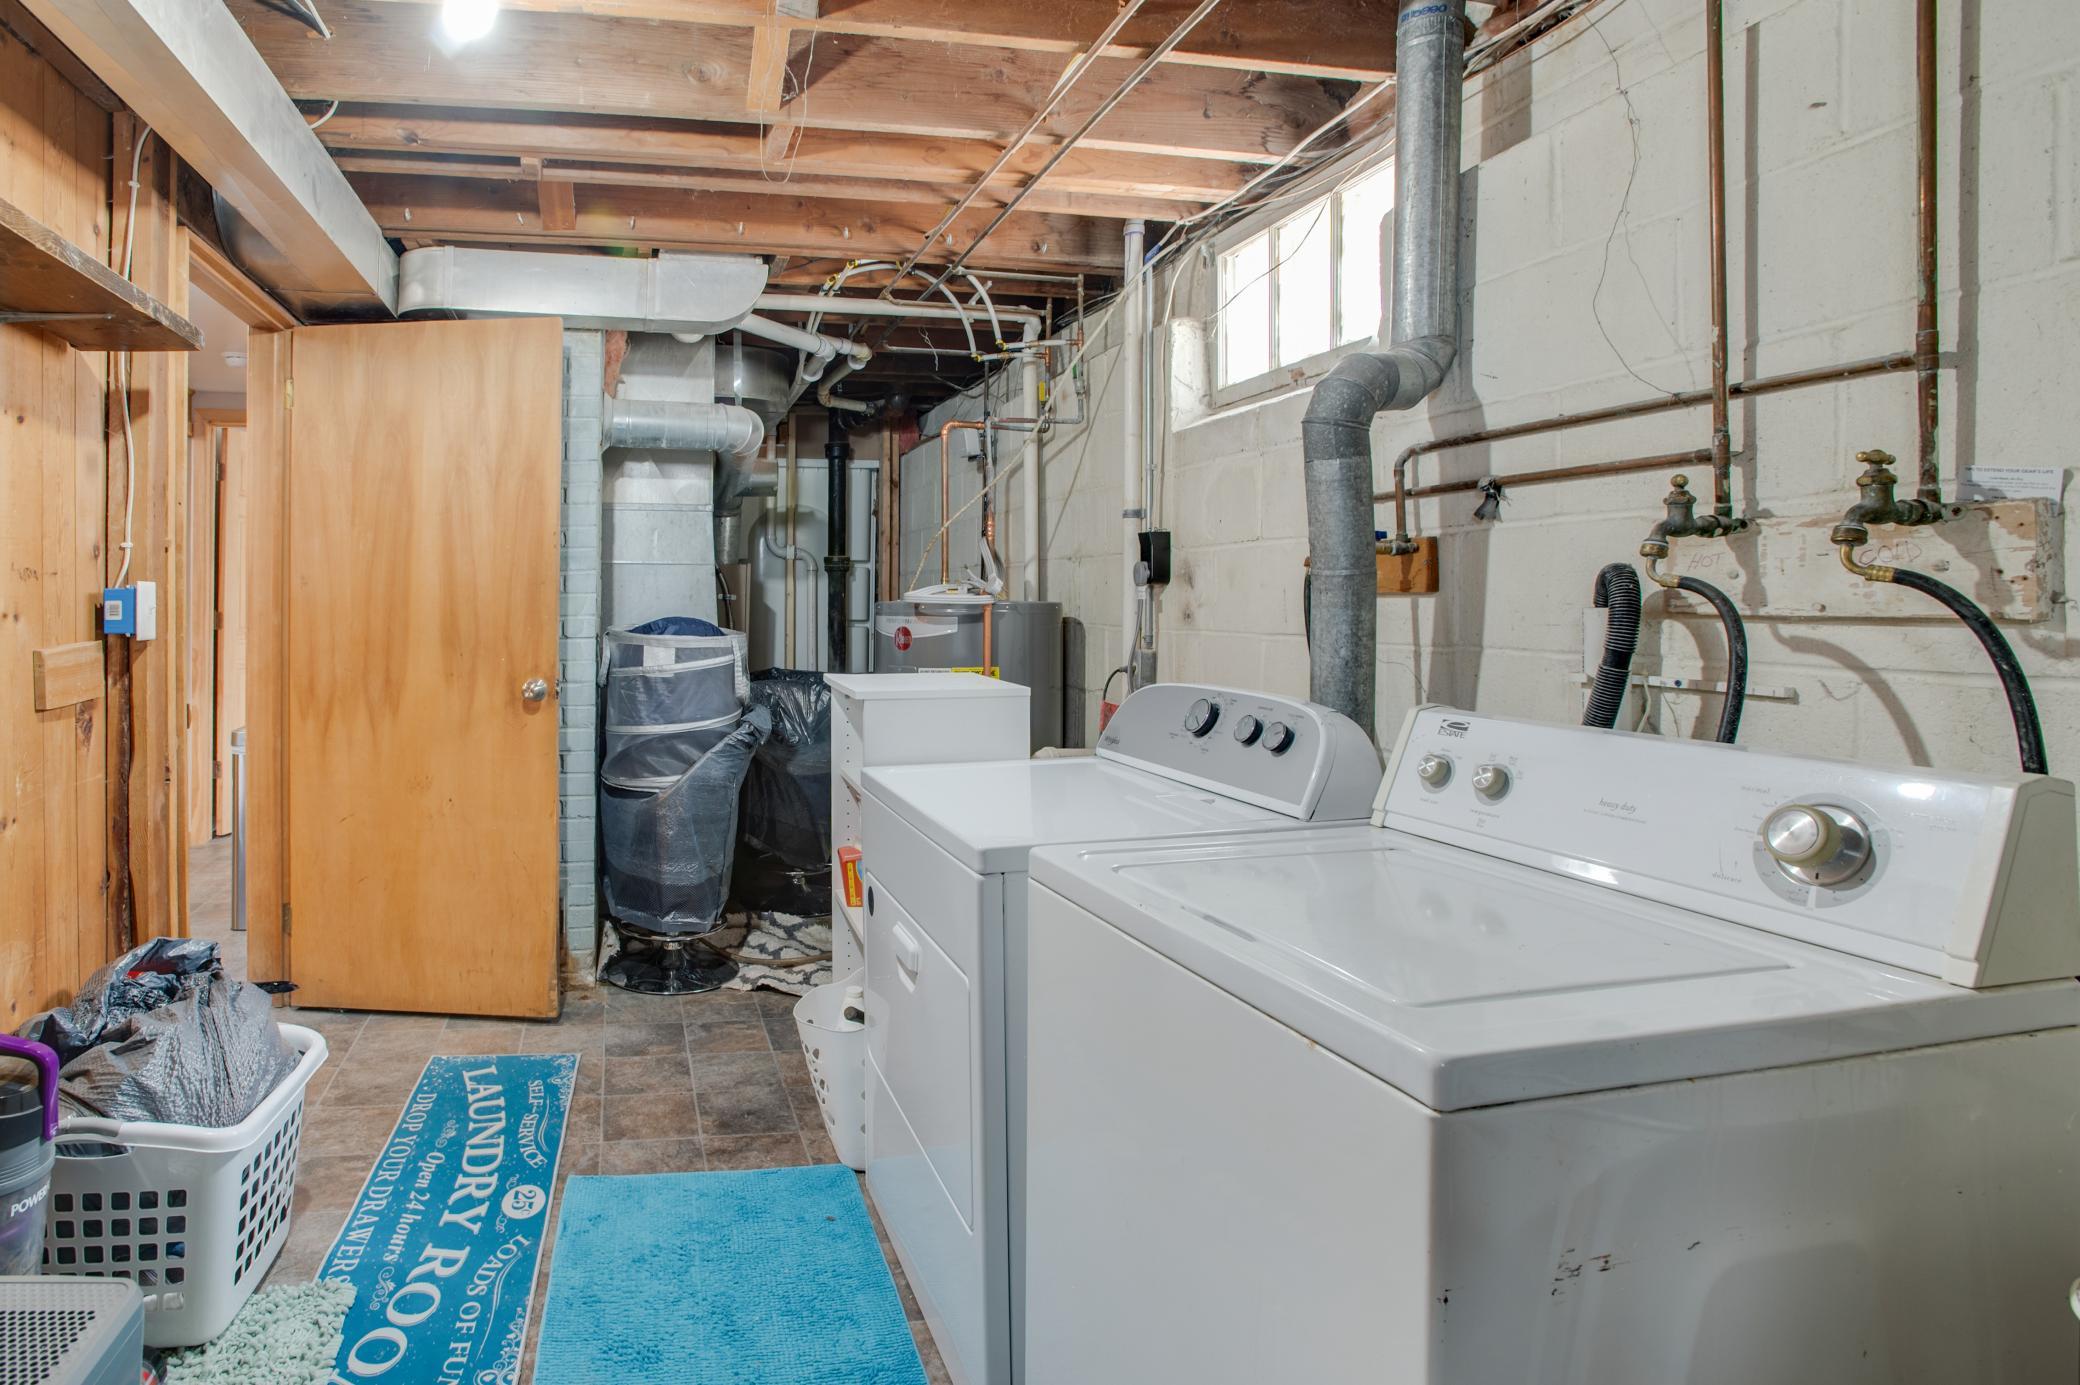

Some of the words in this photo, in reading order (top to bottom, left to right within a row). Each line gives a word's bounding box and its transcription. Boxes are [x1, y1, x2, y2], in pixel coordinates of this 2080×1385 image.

[1686, 552, 1725, 572] HOT
[1859, 540, 1922, 565] COLD
[1437, 728, 1466, 739] ESTATE
[1599, 796, 1619, 812] heavy
[1620, 801, 1637, 815] duty
[402, 1093, 437, 1132] DROP
[518, 1079, 548, 1168] SELF-SERVICE
[374, 1135, 418, 1182] YOUR
[439, 1065, 506, 1235] LAUNDRY
[418, 1152, 446, 1188] Open
[406, 1190, 430, 1210] 24
[383, 1213, 422, 1263] hours
[467, 1234, 531, 1296] LOADS
[328, 1243, 471, 1385] ROO
[456, 1302, 481, 1334] OF
